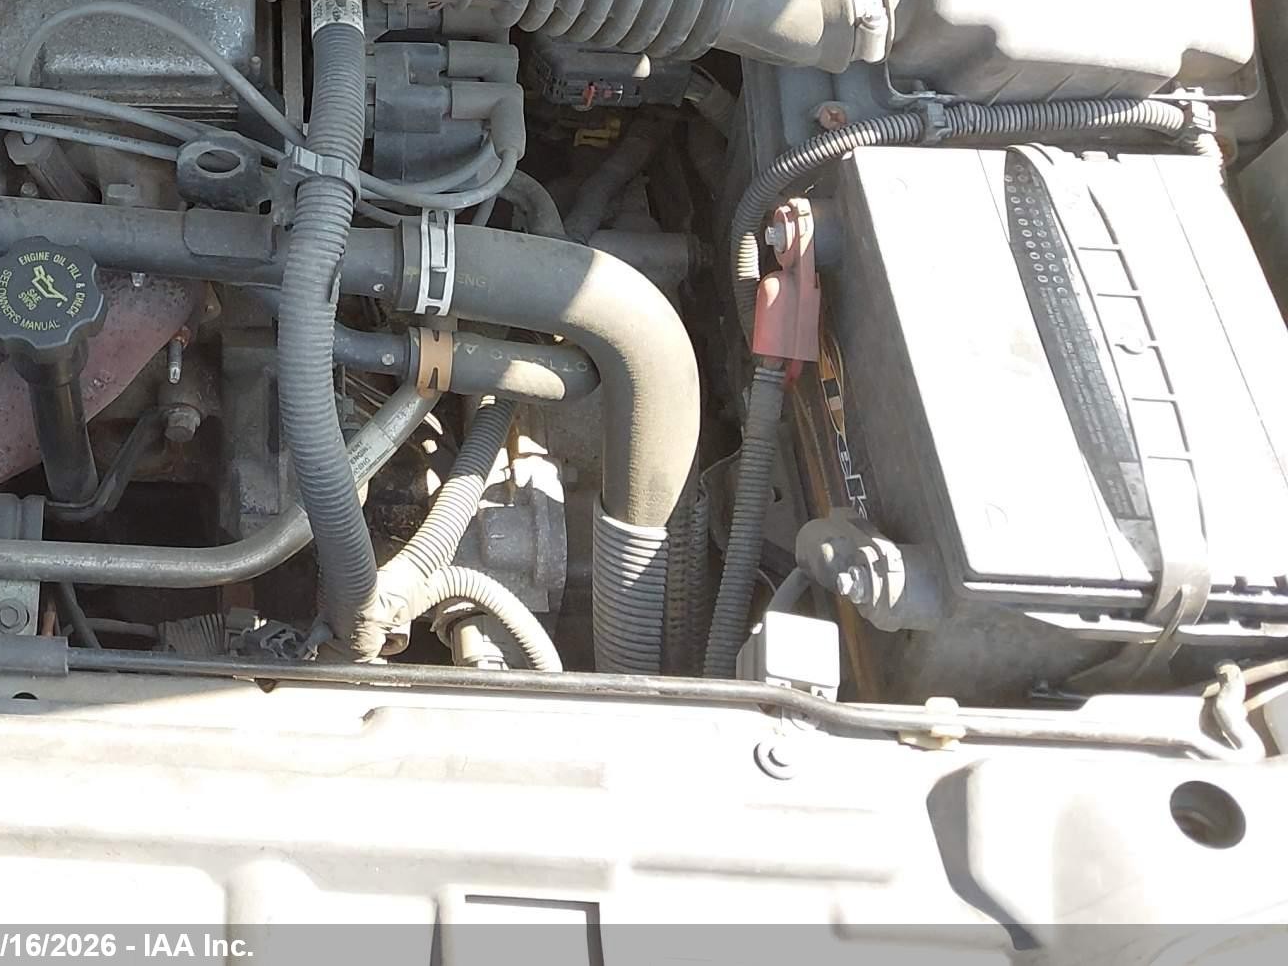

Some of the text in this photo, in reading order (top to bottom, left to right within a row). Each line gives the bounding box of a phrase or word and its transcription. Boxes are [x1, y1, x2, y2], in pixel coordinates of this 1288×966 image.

[18, 251, 50, 265] ENGINE
[53, 254, 67, 266] OIL
[66, 263, 82, 280] FILL
[27, 288, 42, 303] SAE
[66, 292, 85, 317] CHECK
[20, 318, 61, 331] MANUAL
